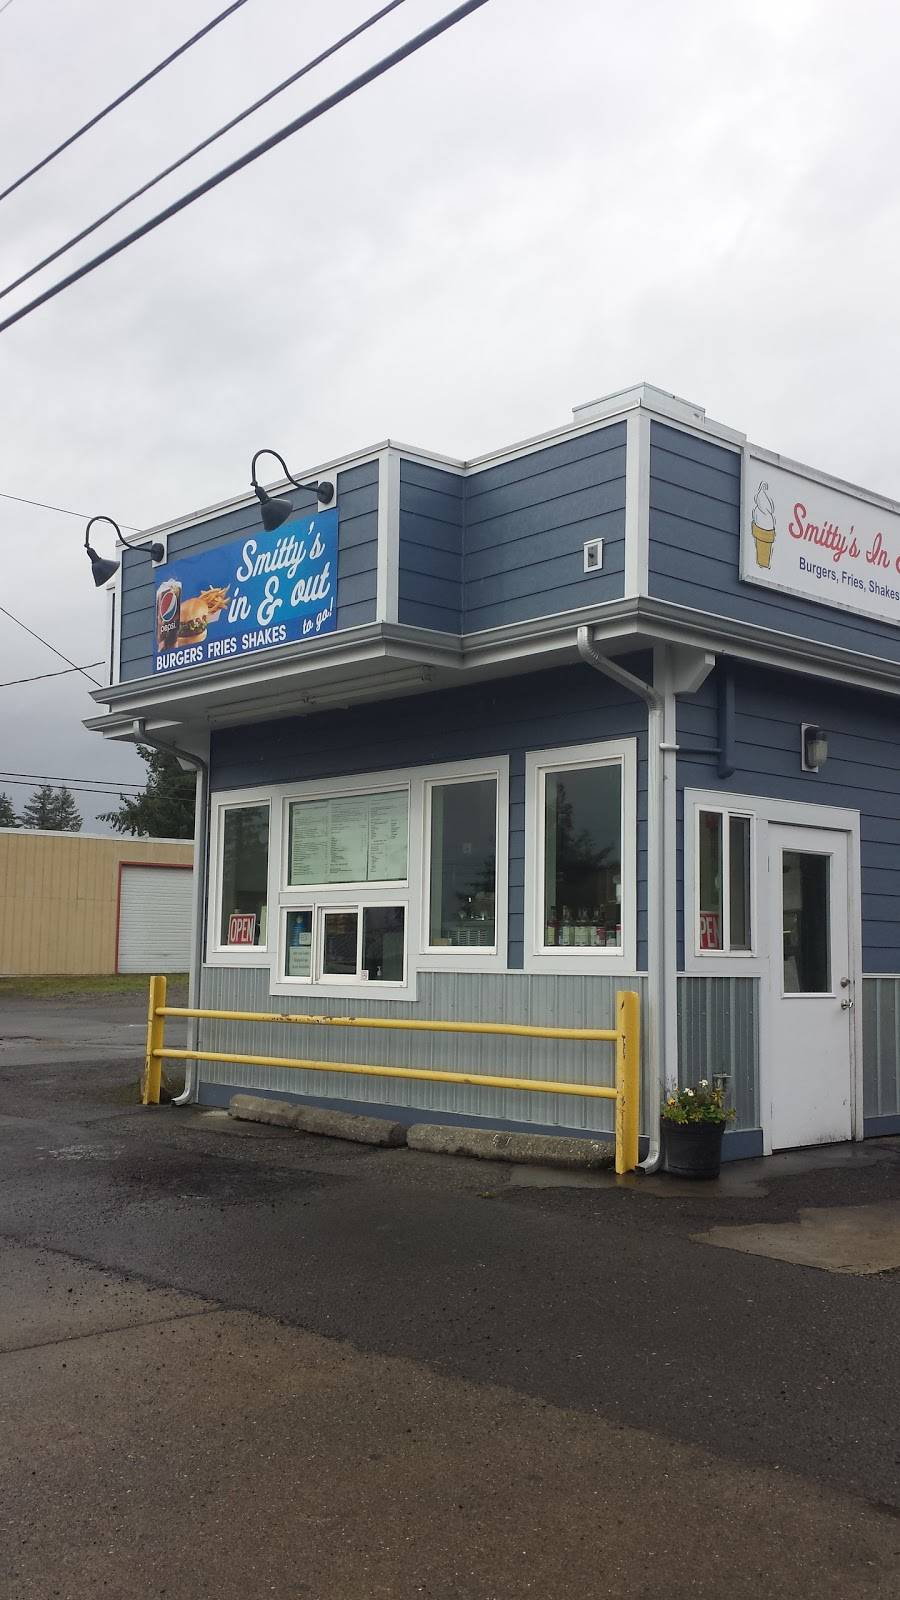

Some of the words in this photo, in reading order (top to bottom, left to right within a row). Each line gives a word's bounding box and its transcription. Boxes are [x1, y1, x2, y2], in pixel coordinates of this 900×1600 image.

[236, 521, 326, 582] Smitty's
[788, 502, 861, 563] Smitty's
[866, 532, 890, 568] In
[228, 587, 251, 623] in
[256, 576, 282, 626] &
[290, 562, 331, 606] out
[799, 556, 840, 584] Burgers,
[841, 570, 866, 592] Fries,
[868, 580, 900, 601] Shakes
[302, 618, 314, 635] to
[315, 596, 334, 632] go!
[156, 645, 203, 671] BURGERS
[207, 637, 237, 659] FRIES
[241, 625, 287, 649] SHAKES
[230, 918, 254, 942] OPEN
[700, 916, 720, 948] PEN
